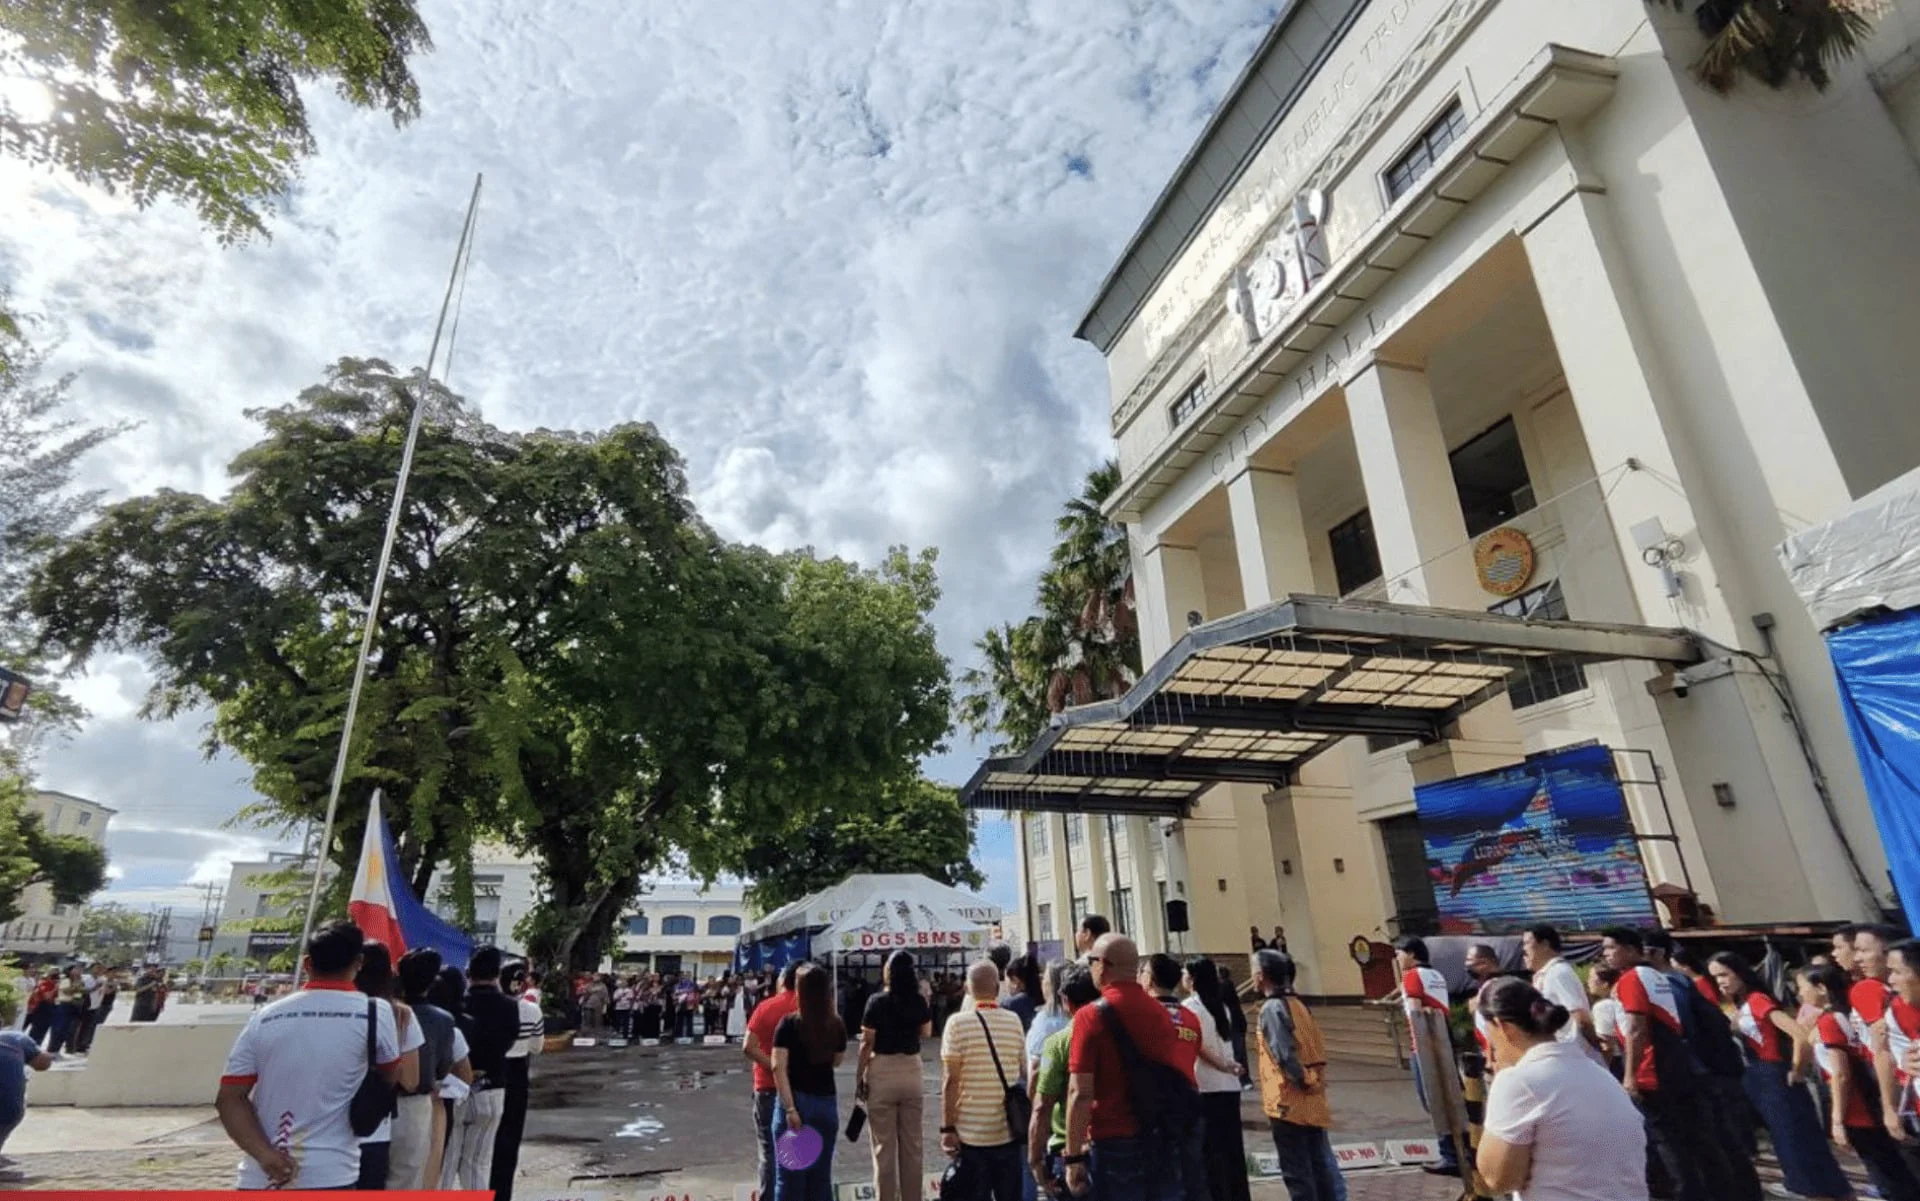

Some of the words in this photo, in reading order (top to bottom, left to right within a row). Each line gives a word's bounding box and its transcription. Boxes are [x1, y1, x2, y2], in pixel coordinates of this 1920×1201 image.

[1360, 0, 1417, 64] TRU
[1211, 405, 1271, 476] CITY
[1296, 310, 1387, 401] HALL
